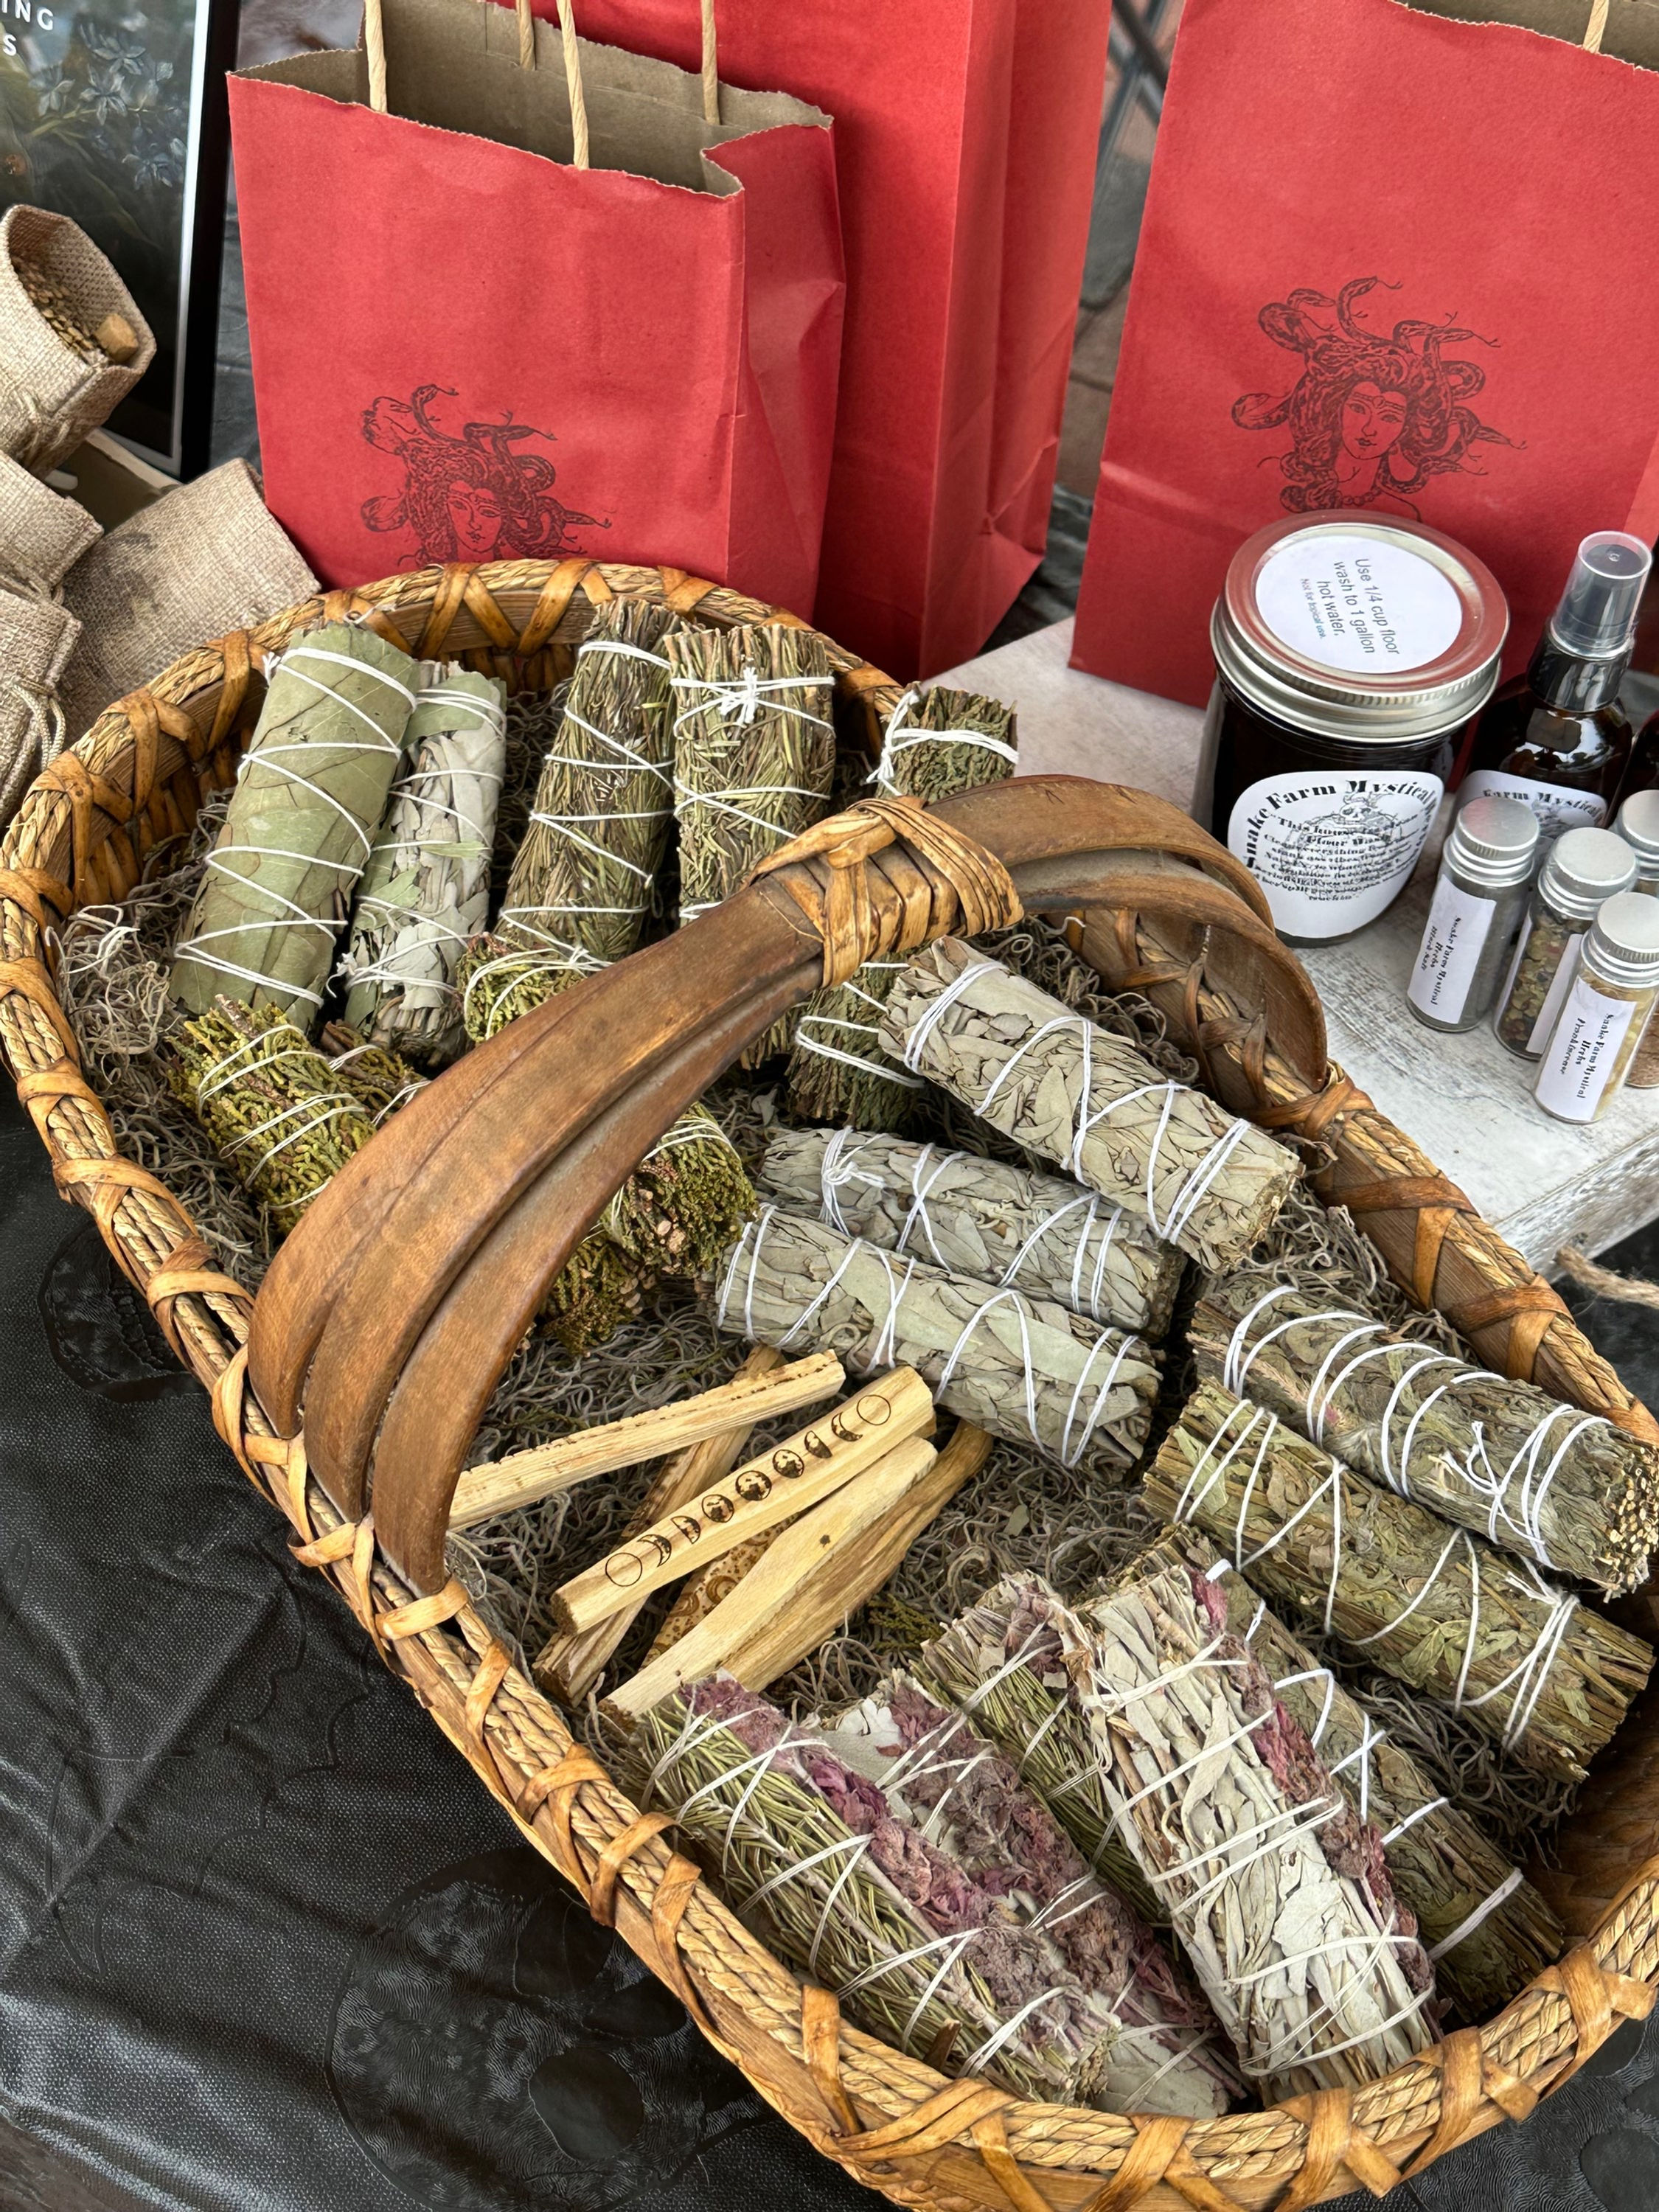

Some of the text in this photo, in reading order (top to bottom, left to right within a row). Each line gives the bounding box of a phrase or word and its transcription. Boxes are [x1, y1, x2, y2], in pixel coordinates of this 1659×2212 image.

[1334, 561, 1355, 591] wash
[1316, 580, 1346, 636] hot water.
[1344, 595, 1358, 606] to
[1355, 558, 1399, 655] Use 1/4 cup floor
[1349, 619, 1375, 653] gallon
[1266, 785, 1337, 810] Farm
[1346, 780, 1436, 804] Mystical
